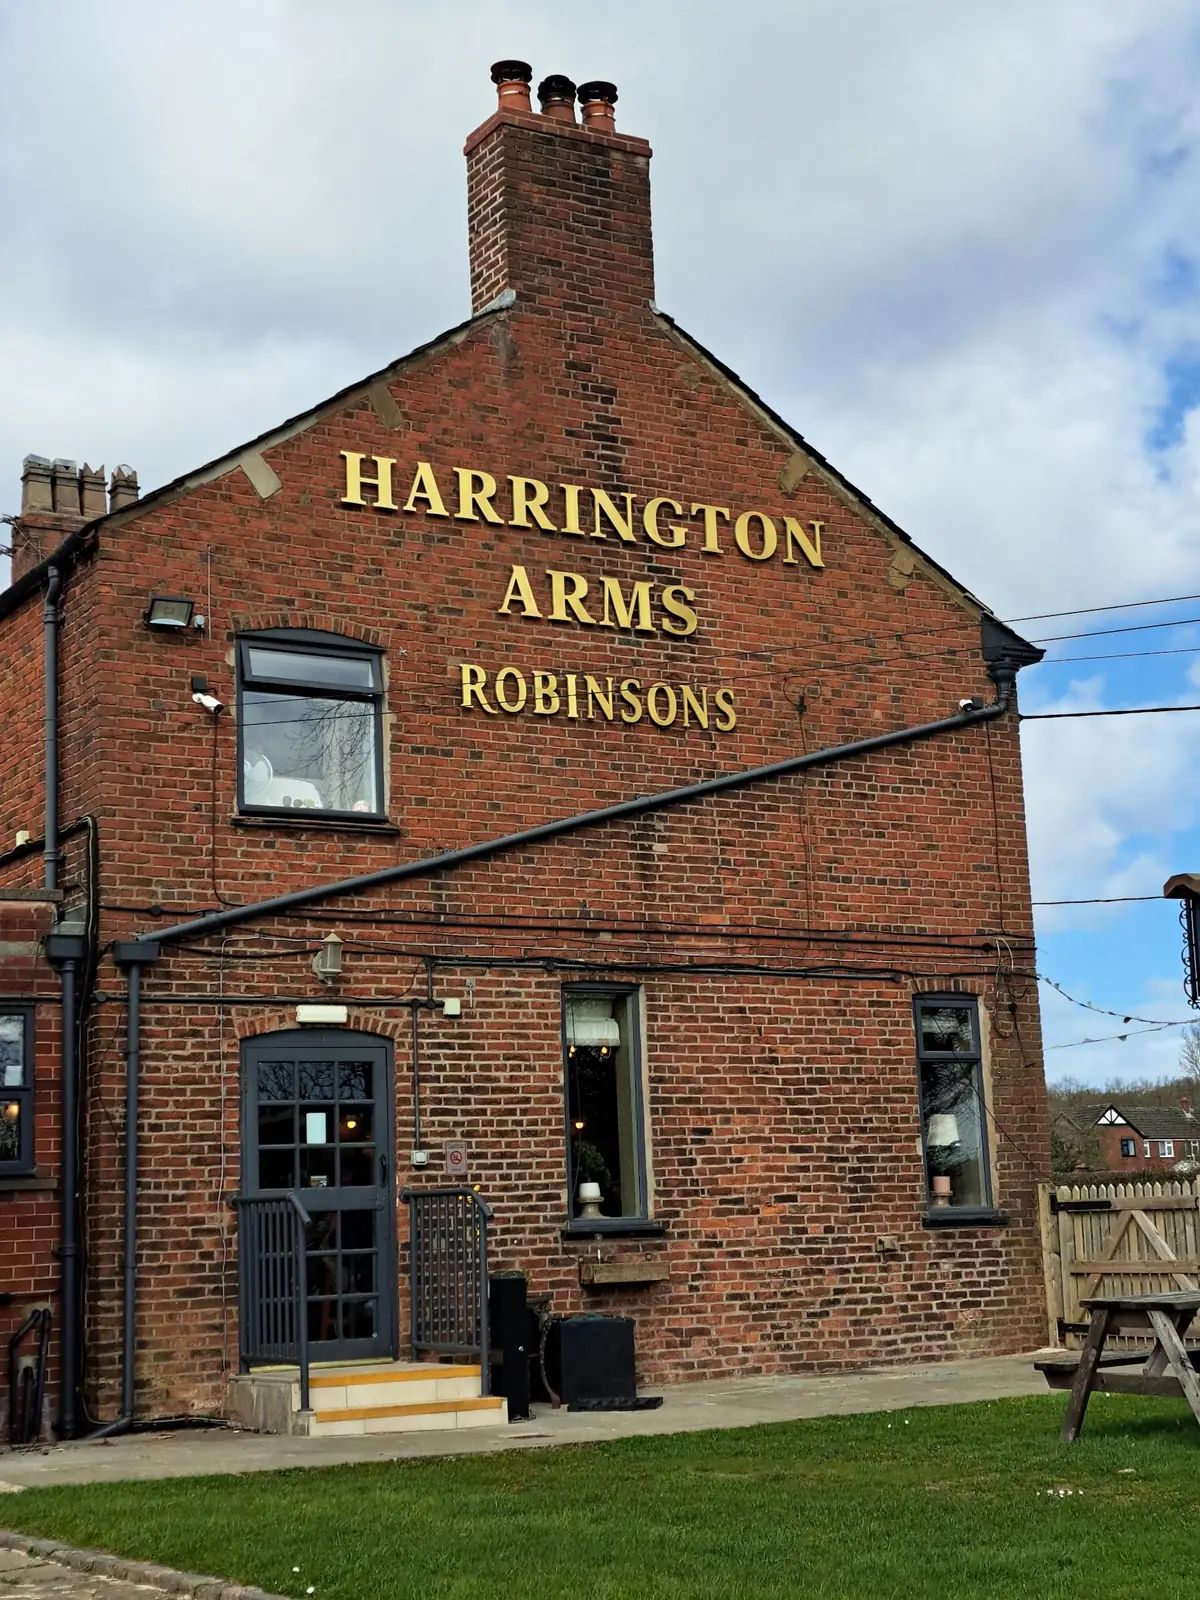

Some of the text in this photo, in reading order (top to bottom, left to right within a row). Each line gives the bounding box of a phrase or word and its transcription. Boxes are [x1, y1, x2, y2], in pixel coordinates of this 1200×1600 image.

[340, 450, 825, 568] HARRINGTON
[498, 565, 698, 637] ARMS
[459, 663, 737, 732] ROBINSONS
